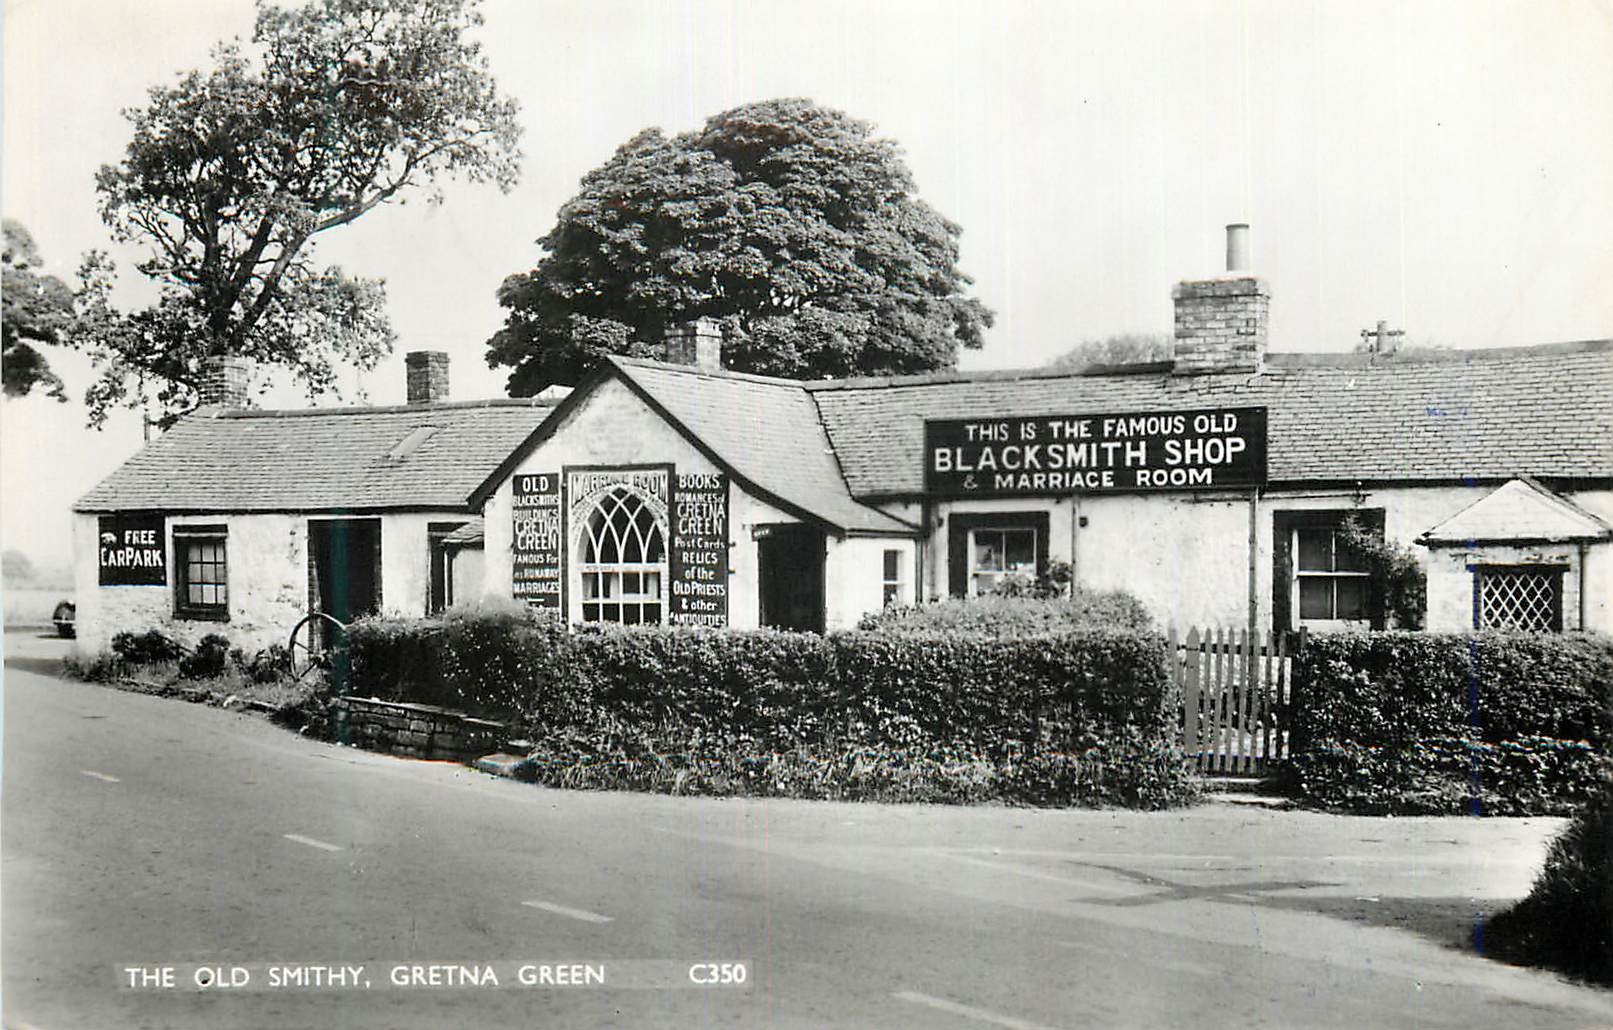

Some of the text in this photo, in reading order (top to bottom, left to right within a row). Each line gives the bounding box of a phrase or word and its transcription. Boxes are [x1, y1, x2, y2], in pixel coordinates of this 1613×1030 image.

[965, 413, 1237, 441] THIS IS THE FAMOUS OLD
[934, 437, 1246, 472] BLACKSMITH SHOP
[522, 476, 549, 492] OLD
[964, 475, 978, 490] &
[1136, 467, 1213, 486] ROOM
[633, 473, 668, 502] ROOM
[124, 530, 156, 545] FREE
[513, 553, 544, 564] FAMOUS
[682, 551, 718, 564] RELICS
[685, 566, 715, 580] of the
[673, 580, 726, 596] OLD PRIESTS
[681, 597, 718, 611] & other
